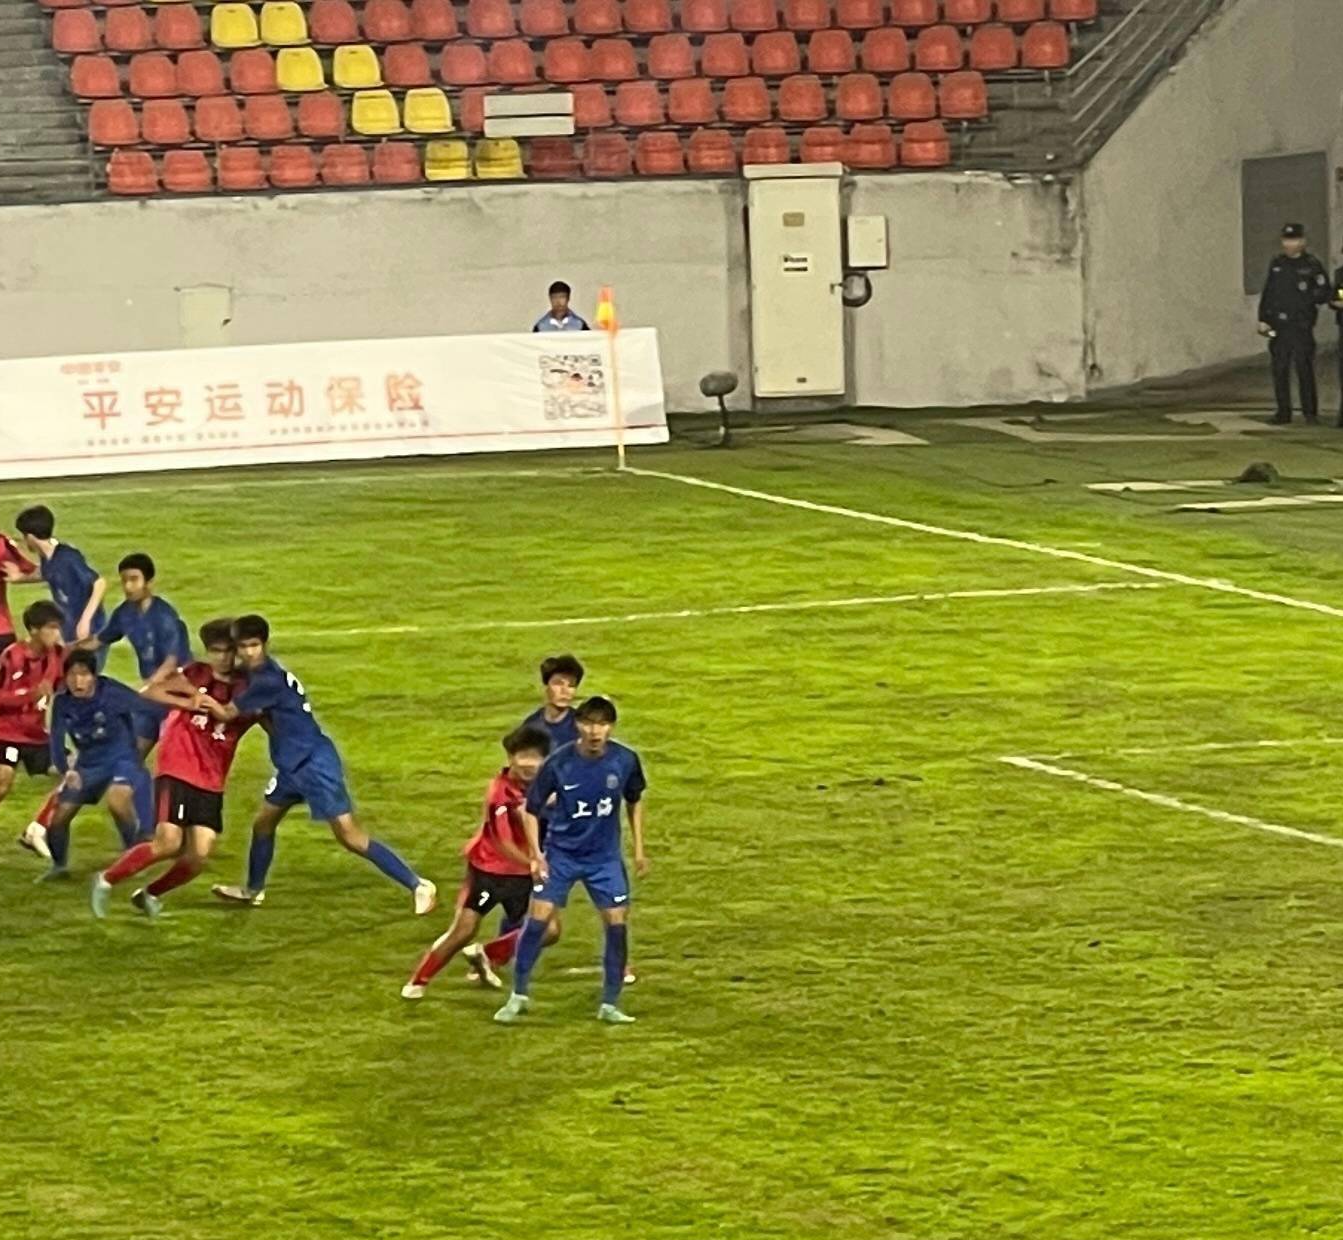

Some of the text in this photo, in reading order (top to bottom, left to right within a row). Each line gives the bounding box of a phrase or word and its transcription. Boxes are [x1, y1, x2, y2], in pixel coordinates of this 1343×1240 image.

[82, 372, 424, 430] 平安运动保险
